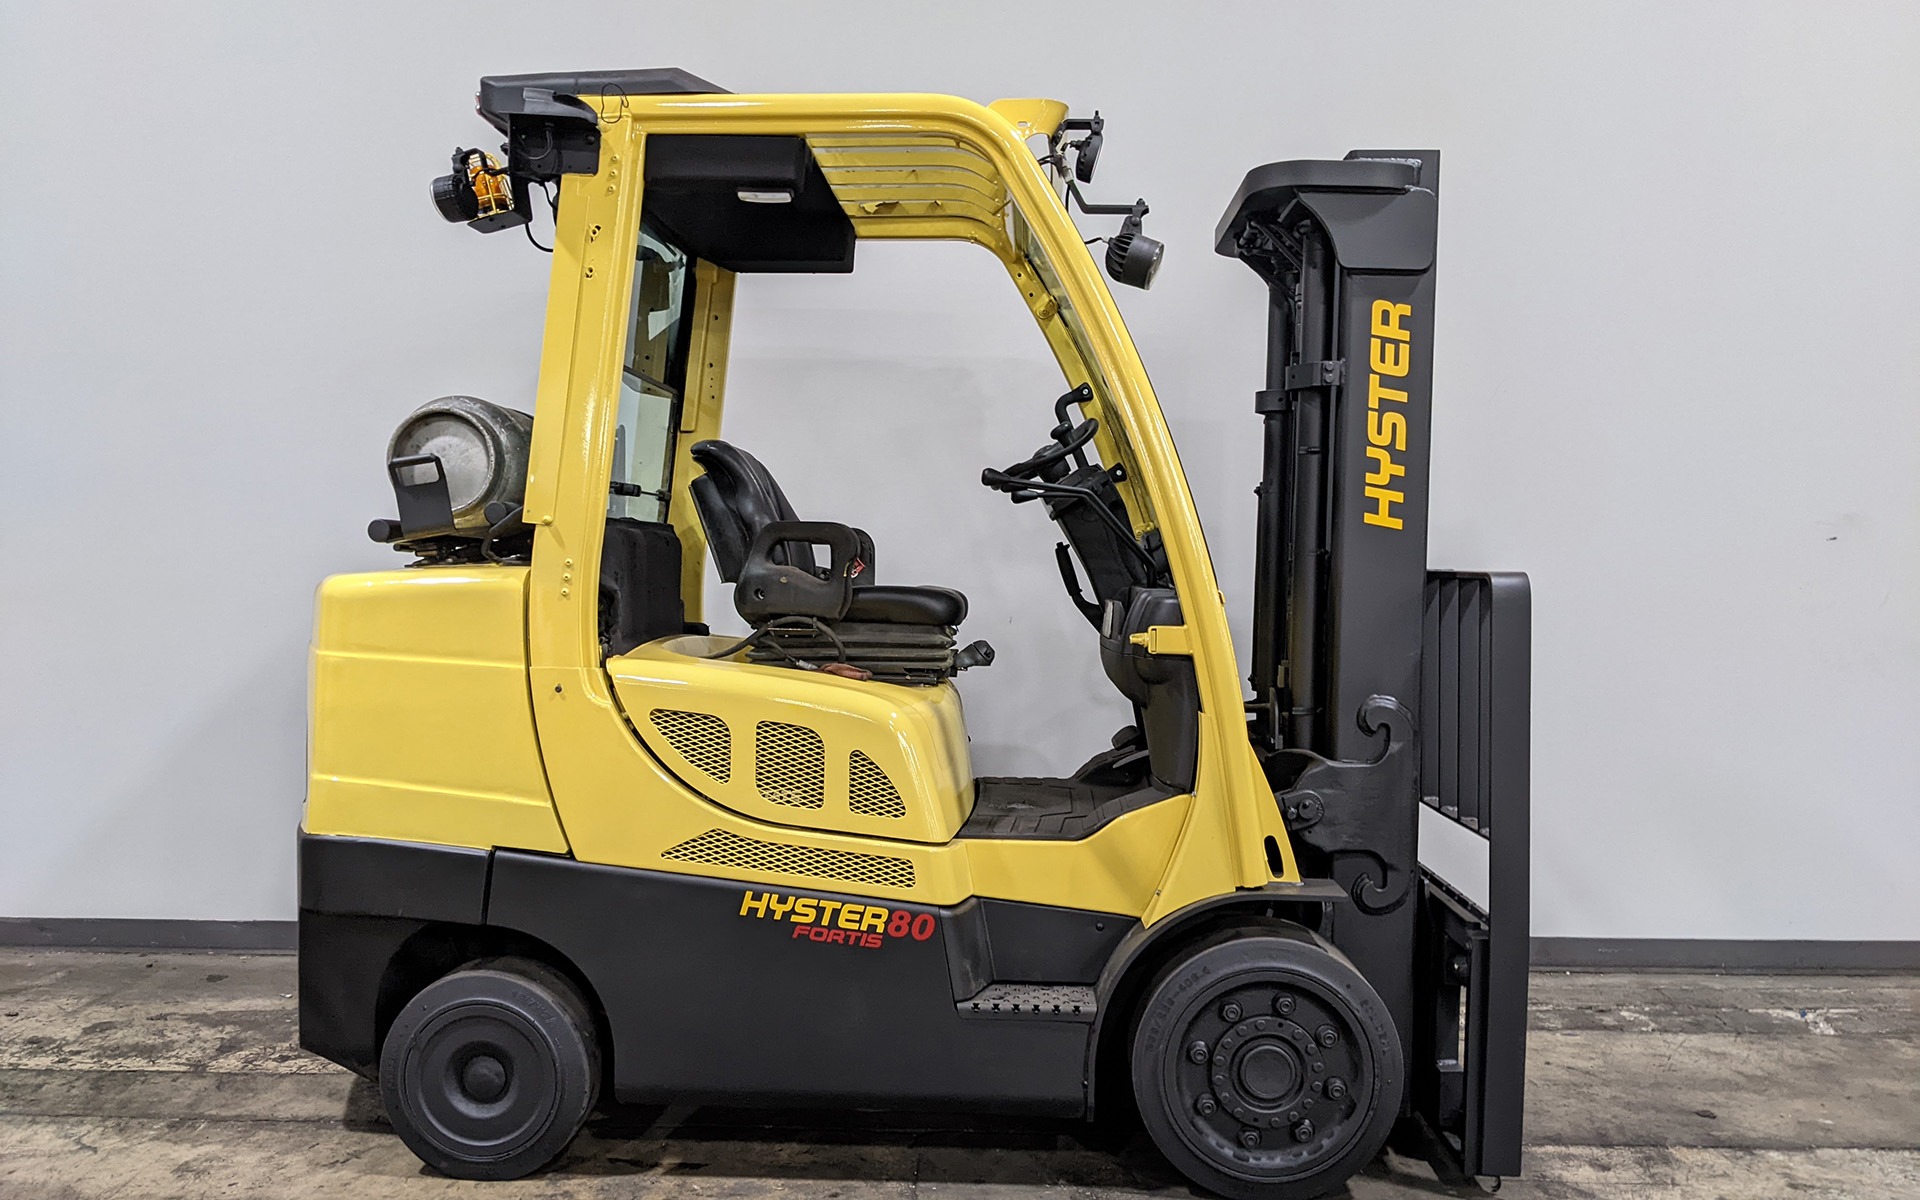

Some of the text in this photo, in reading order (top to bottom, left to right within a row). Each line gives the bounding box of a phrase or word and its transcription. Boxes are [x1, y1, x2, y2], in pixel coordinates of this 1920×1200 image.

[1363, 299, 1412, 530] HYSTER
[739, 891, 935, 941] HYSTER 80
[792, 926, 883, 948] FORTIS
